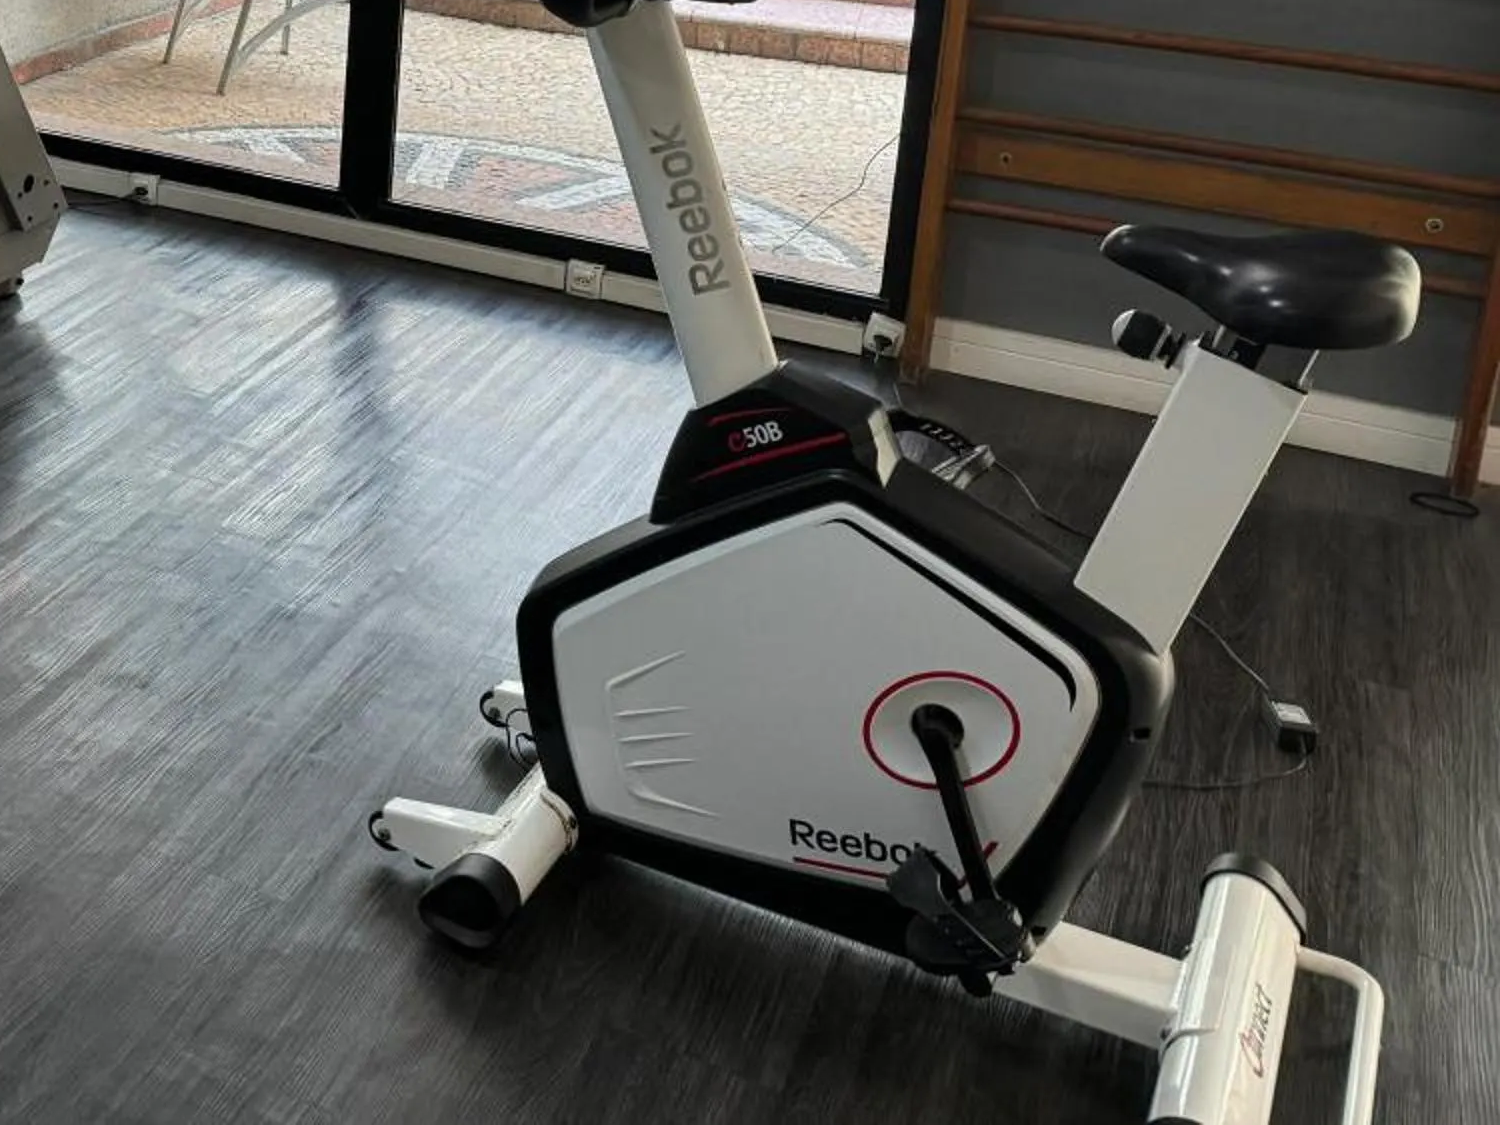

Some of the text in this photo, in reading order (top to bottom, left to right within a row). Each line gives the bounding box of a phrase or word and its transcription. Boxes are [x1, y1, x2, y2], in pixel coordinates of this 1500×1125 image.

[650, 122, 731, 296] Reebok
[728, 420, 783, 452] C50B
[789, 818, 923, 866] Reebo
